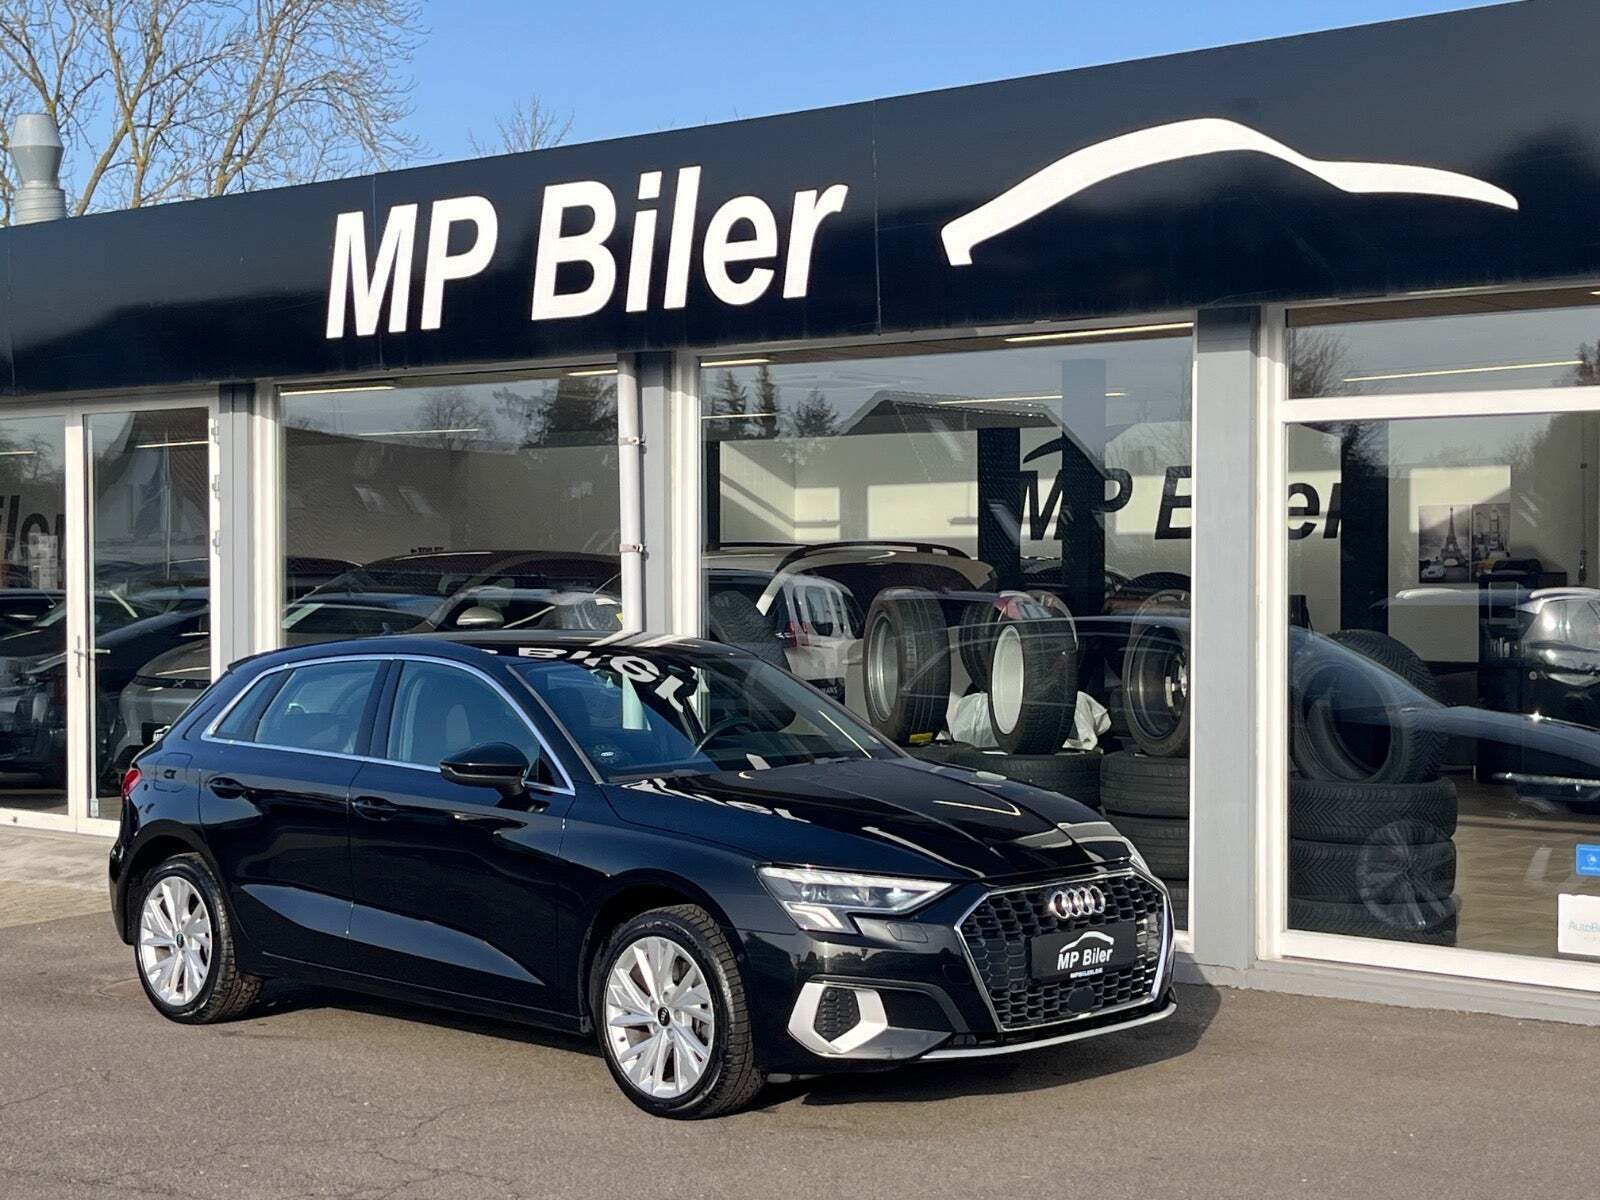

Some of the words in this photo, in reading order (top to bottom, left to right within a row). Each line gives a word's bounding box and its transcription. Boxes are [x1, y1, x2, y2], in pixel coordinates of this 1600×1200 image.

[326, 196, 498, 339] MP
[531, 165, 848, 321] Biler
[1057, 951, 1080, 970] MP
[1083, 947, 1113, 966] Biler
